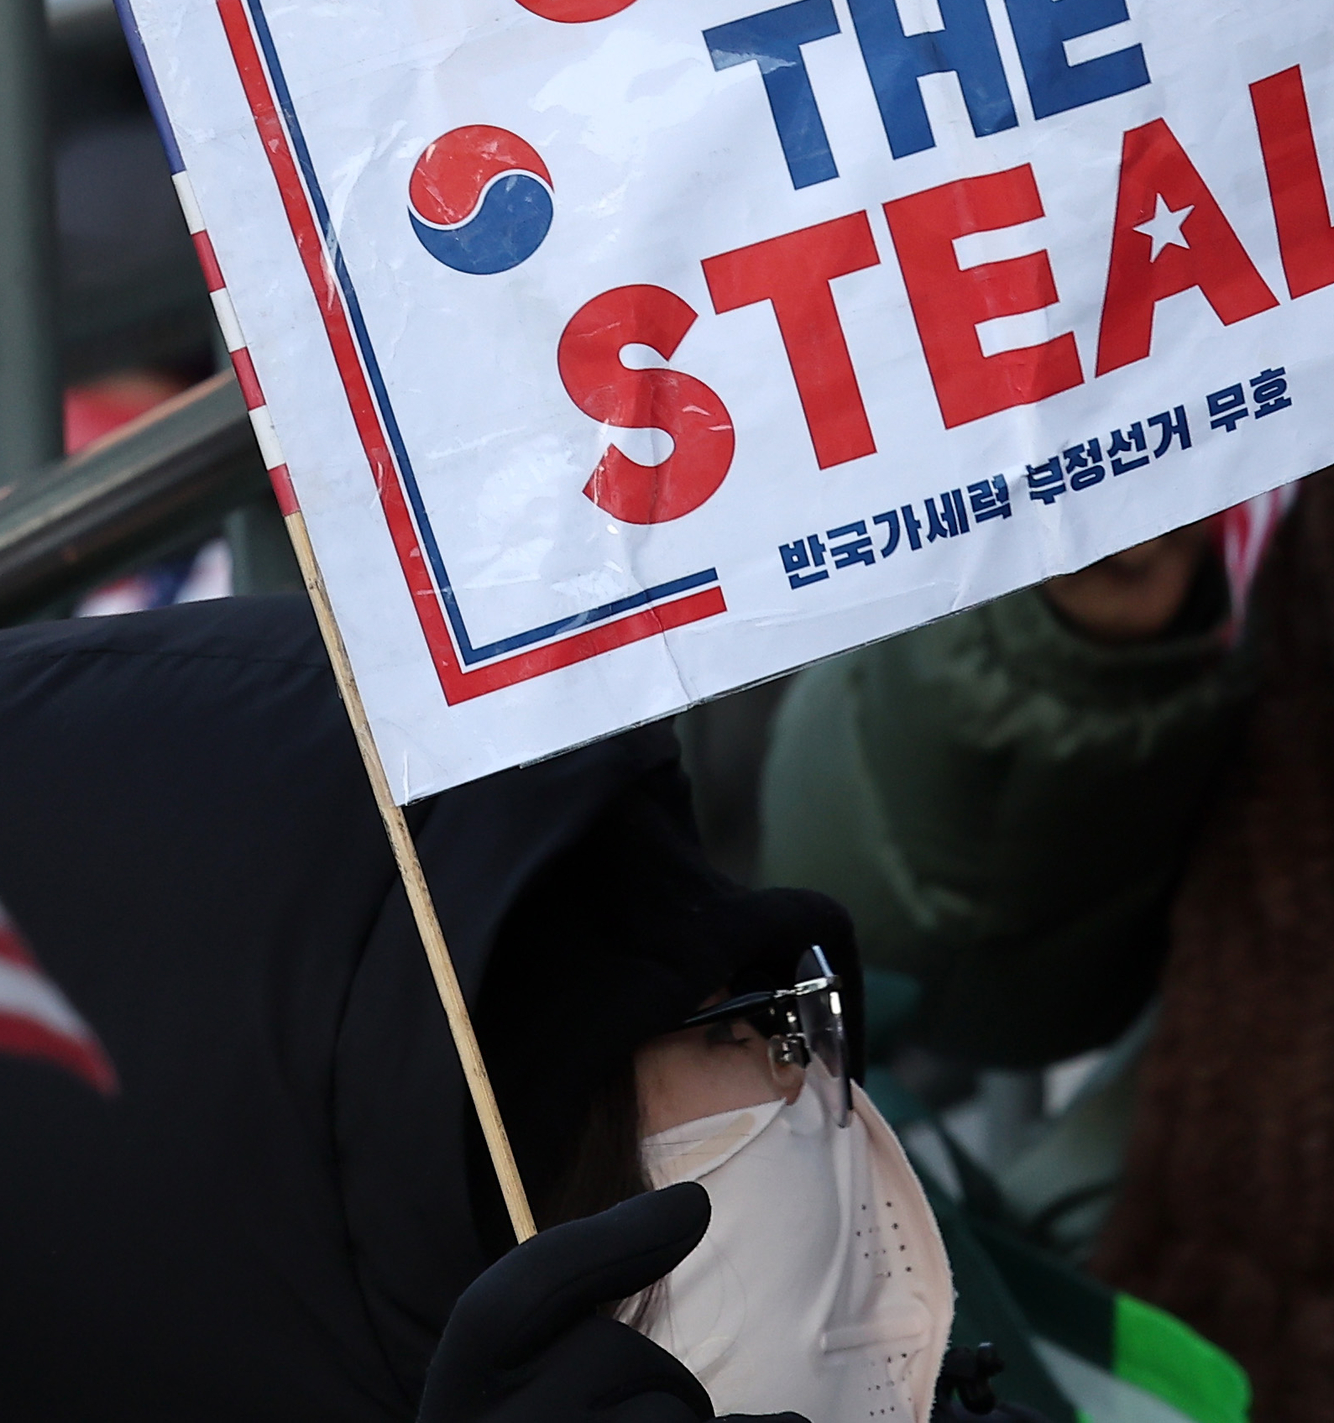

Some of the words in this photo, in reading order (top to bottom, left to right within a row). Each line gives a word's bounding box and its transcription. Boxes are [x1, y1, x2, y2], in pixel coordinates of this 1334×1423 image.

[777, 473, 1013, 591] 반국가세력
[1022, 404, 1194, 506] 부정선거
[1205, 366, 1294, 434] 무효
